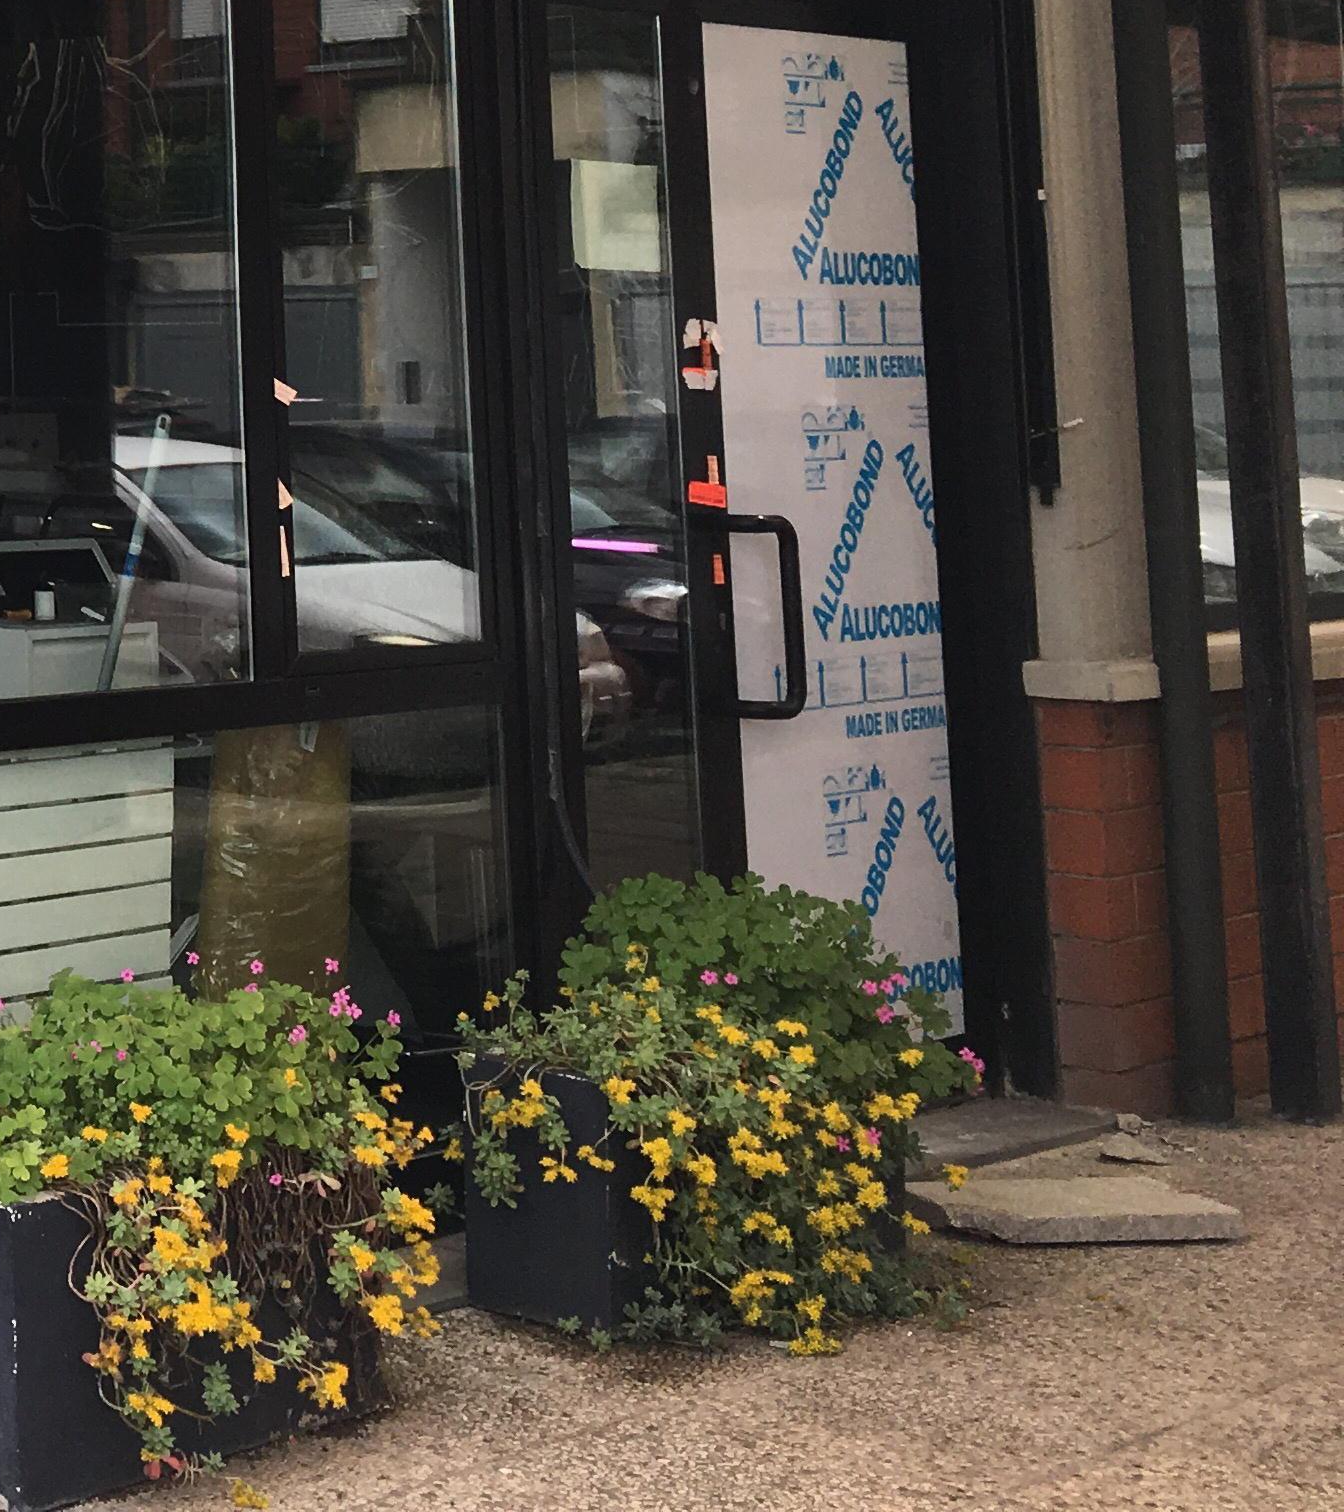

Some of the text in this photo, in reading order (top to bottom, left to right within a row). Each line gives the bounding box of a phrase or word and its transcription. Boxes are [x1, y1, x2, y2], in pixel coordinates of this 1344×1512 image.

[792, 91, 863, 280] ALUCOBOND
[875, 97, 916, 202] ALUC
[824, 355, 925, 378] MADE IN GERMA
[813, 439, 884, 641] ALUCOBOND
[895, 442, 939, 548] ALUC
[845, 704, 946, 738] MADE IN GERMA
[917, 795, 960, 899] ALUC
